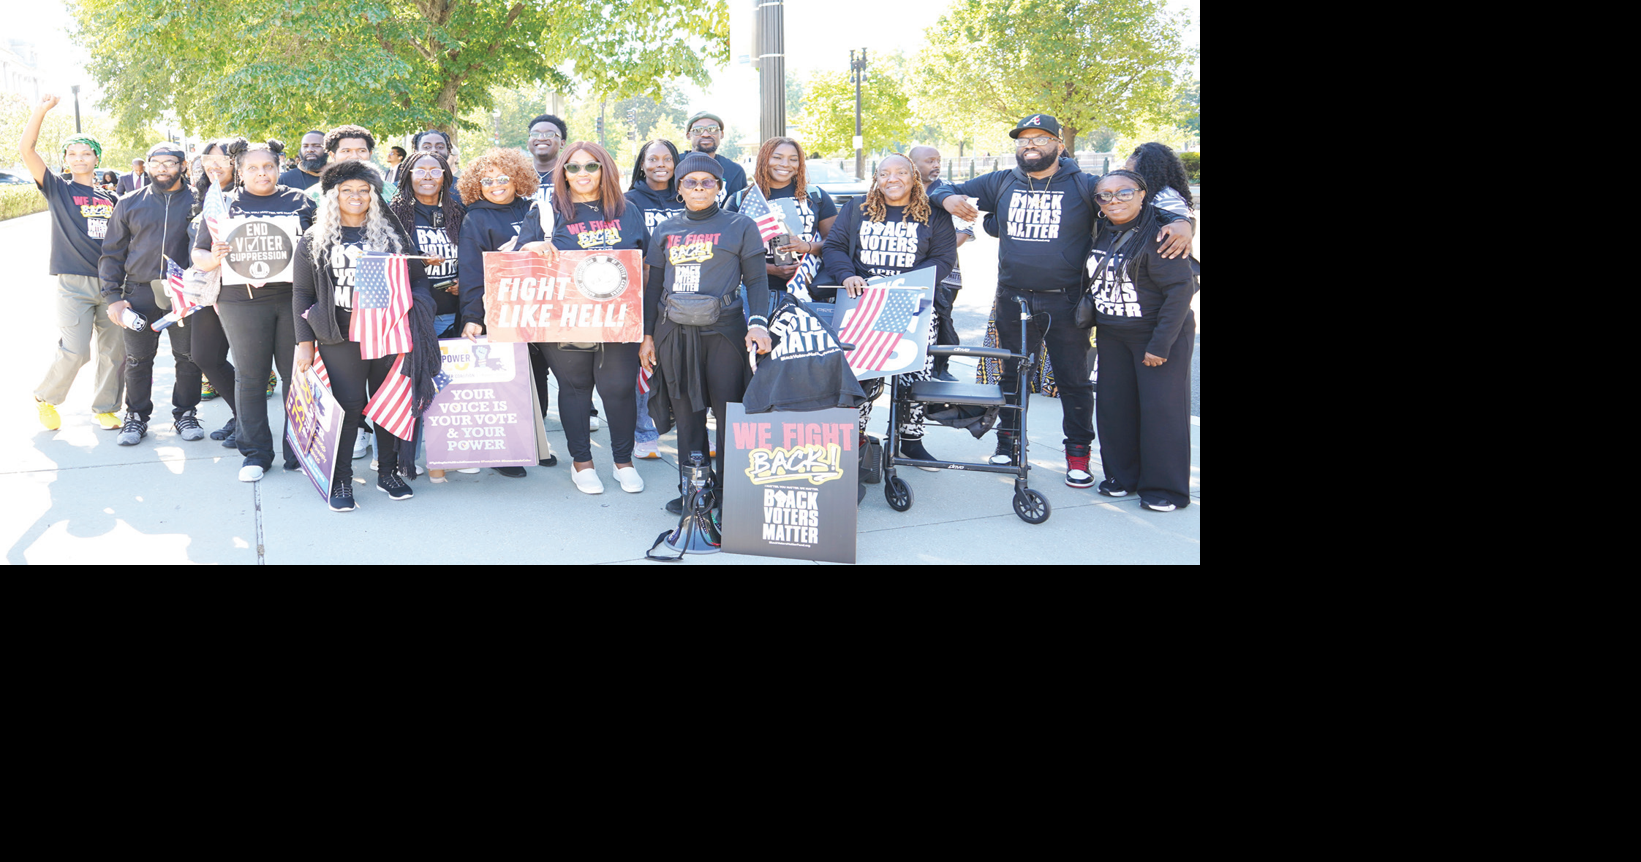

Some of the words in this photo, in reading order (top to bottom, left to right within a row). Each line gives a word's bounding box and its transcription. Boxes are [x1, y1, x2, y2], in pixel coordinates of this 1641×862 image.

[73, 196, 90, 206] WE
[1010, 192, 1064, 210] BACK
[1008, 207, 1062, 224] VOTERS
[246, 223, 268, 236] END
[566, 222, 588, 235] WE
[589, 219, 622, 233] FIGHT
[860, 220, 919, 238] BACK
[1006, 221, 1060, 239] MATTER
[685, 233, 721, 247] FIGHT
[860, 235, 918, 253] VOTERS
[230, 251, 287, 262] SUPPRESSION
[669, 242, 714, 265] BACK!
[860, 250, 916, 267] MATTER
[497, 277, 571, 301] FIGHT
[498, 304, 553, 327] LIKE
[560, 304, 628, 327] HELL!
[451, 389, 495, 400] YOUR
[439, 402, 490, 413] VOICE
[493, 401, 507, 412] IS
[428, 415, 473, 426] YOUR
[474, 413, 517, 424] VOTE
[446, 428, 459, 438] &
[461, 427, 506, 437] YOUR
[733, 422, 773, 450] WE
[782, 422, 854, 451] FIGHT
[447, 439, 506, 451] POWER
[747, 444, 841, 481] BACK!
[764, 489, 818, 510] BACK
[764, 507, 818, 527] VOTERS
[763, 524, 818, 544] MATTER
